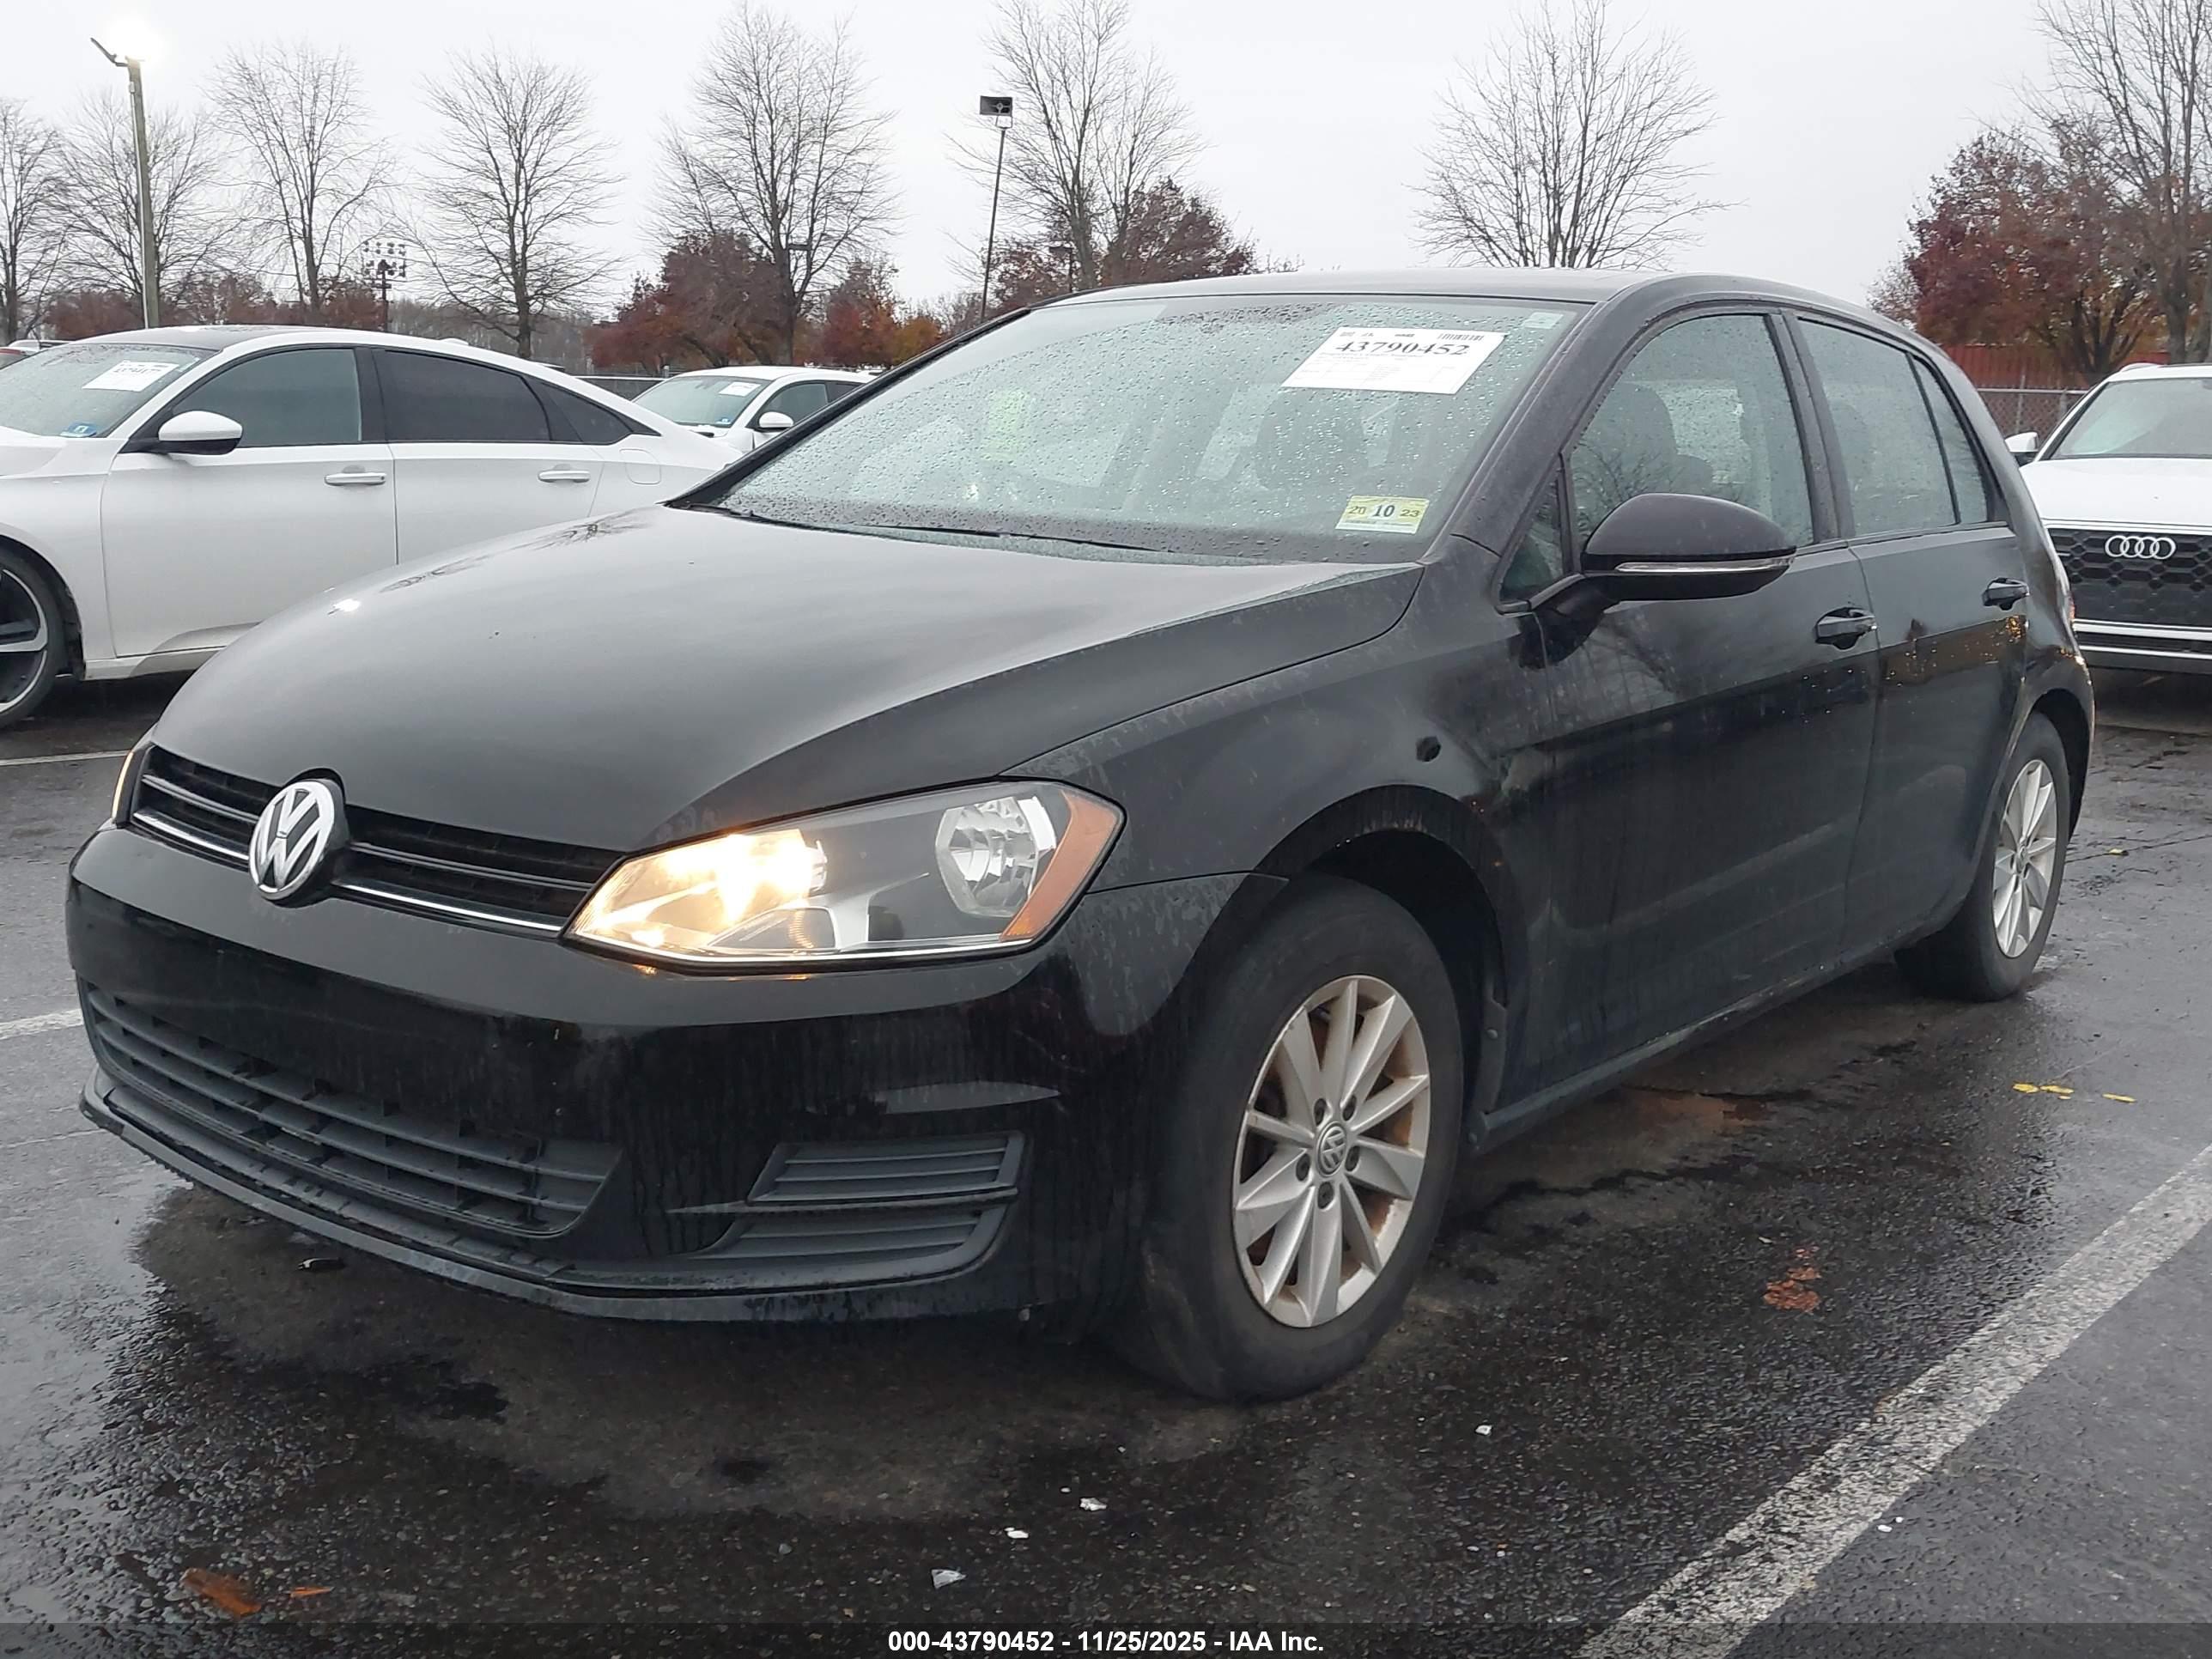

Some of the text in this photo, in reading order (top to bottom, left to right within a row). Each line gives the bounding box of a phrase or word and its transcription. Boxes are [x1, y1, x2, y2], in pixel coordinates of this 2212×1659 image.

[1335, 341, 1469, 356] 43790452
[1372, 505, 1395, 517] 10
[1400, 508, 1420, 518] 23
